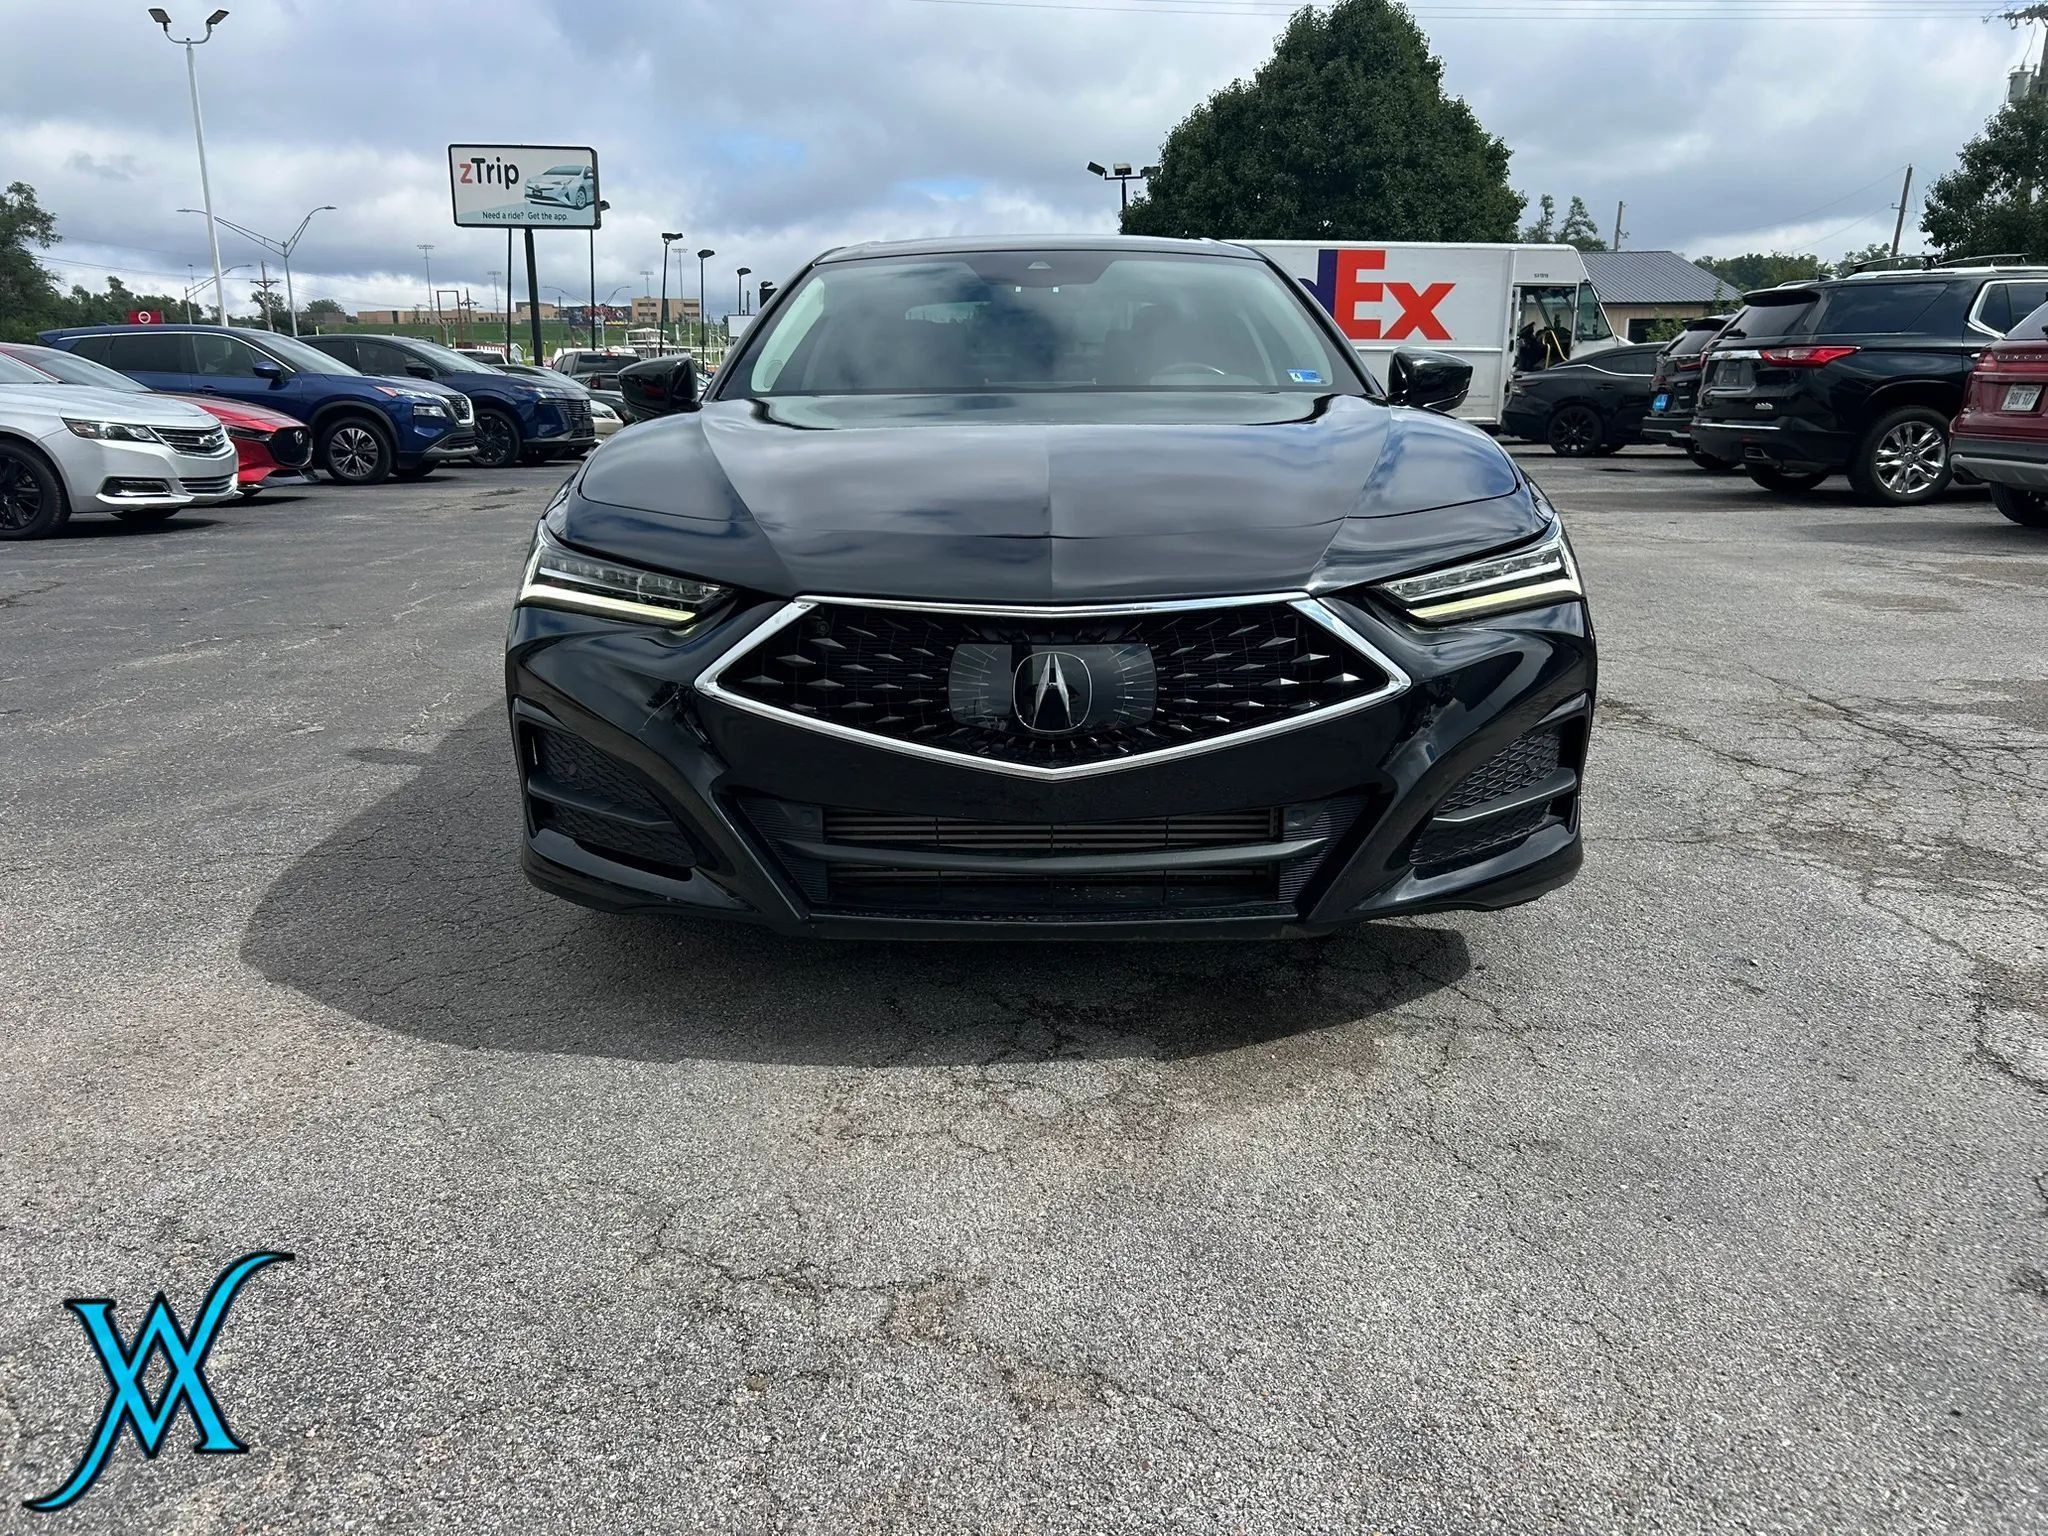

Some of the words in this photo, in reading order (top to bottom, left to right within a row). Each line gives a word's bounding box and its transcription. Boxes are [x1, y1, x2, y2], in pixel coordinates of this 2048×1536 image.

[459, 156, 520, 190] zTrip
[482, 211, 501, 219] Need
[507, 211, 525, 220] ride?
[527, 211, 540, 220] Get
[541, 211, 553, 220] the
